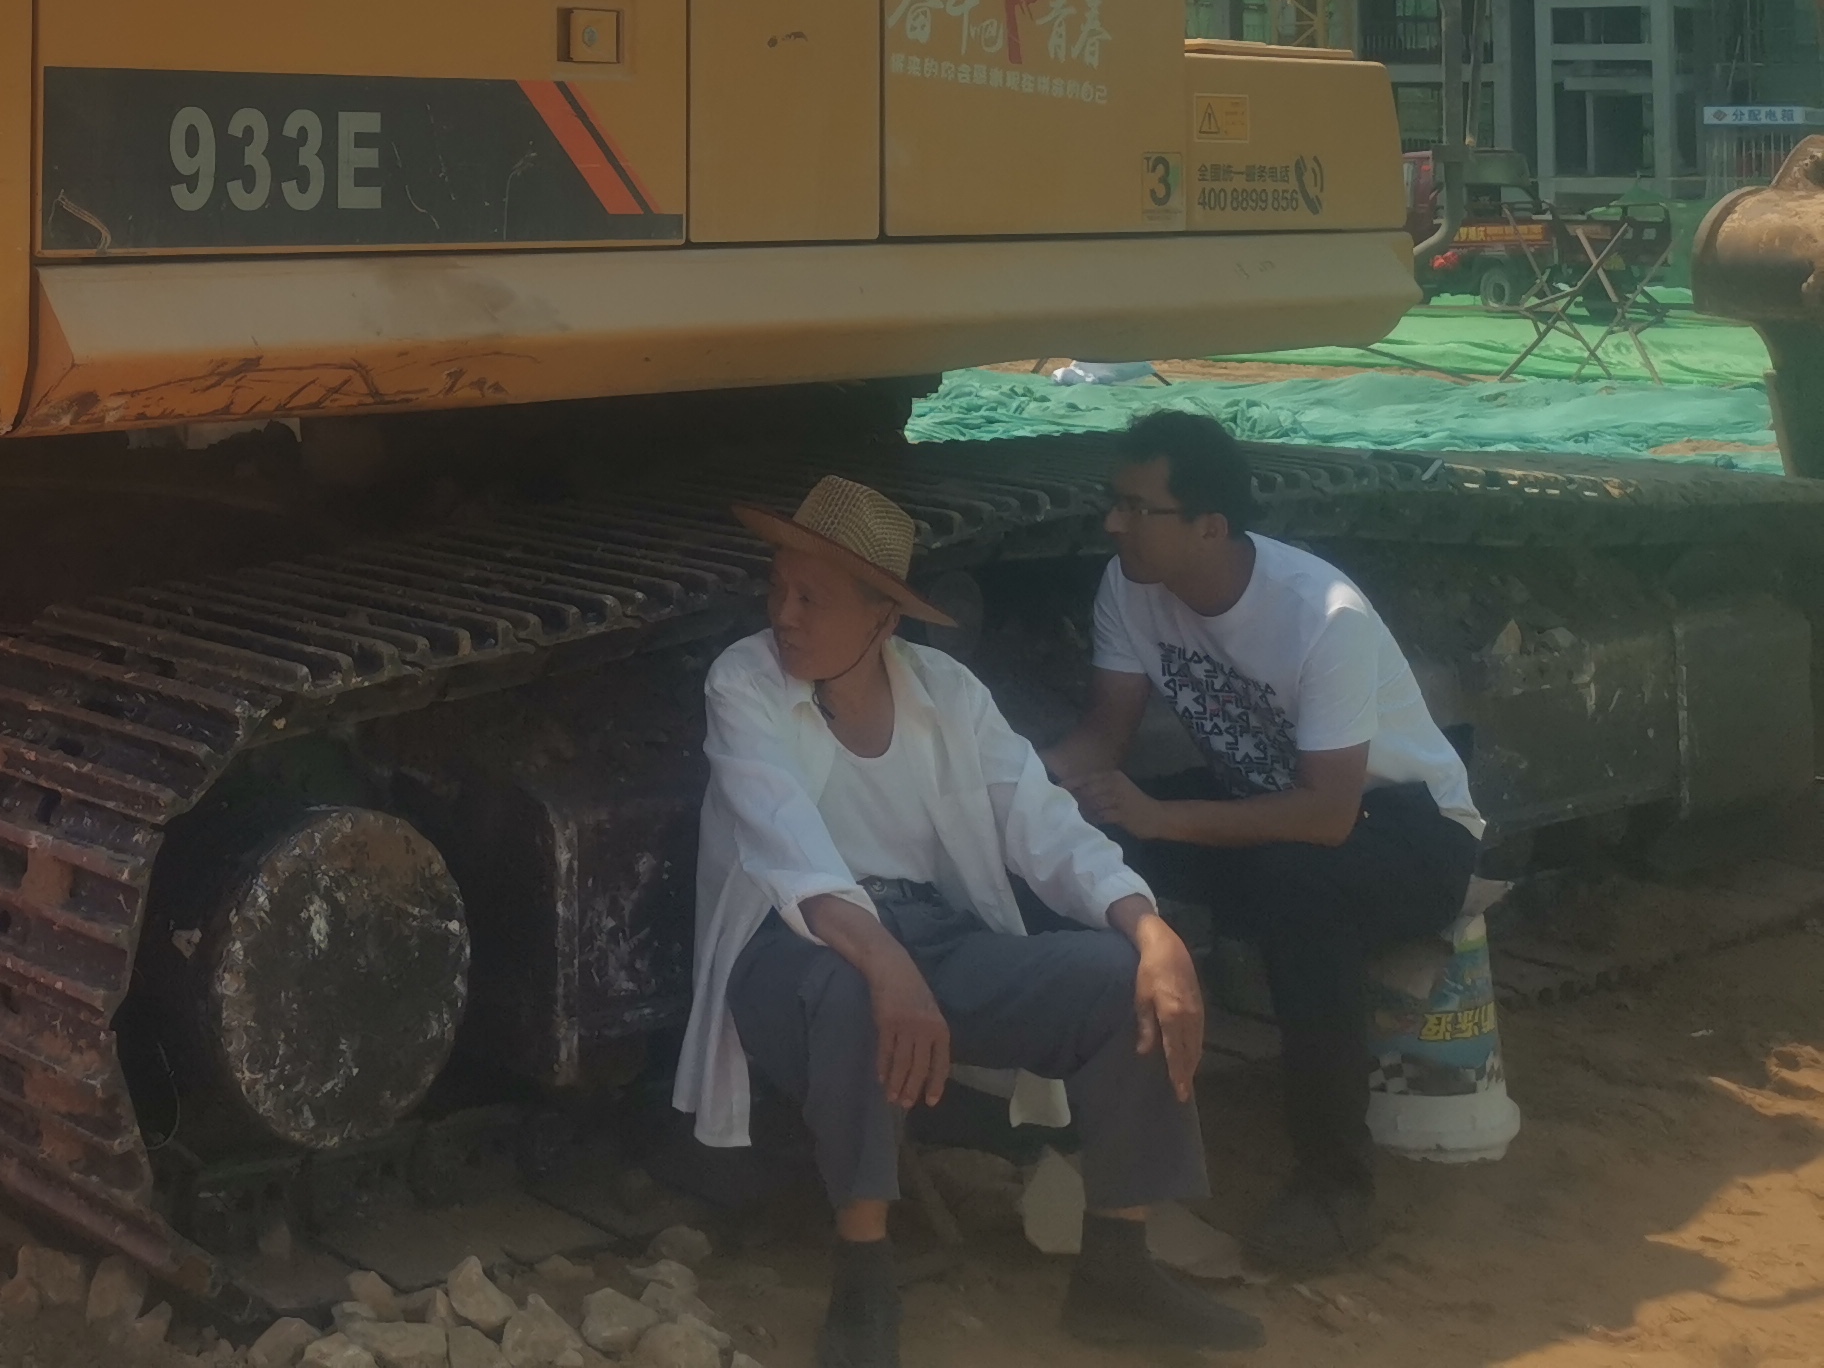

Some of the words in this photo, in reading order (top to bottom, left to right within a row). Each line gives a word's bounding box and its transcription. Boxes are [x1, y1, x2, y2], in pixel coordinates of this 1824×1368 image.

[169, 106, 383, 212] 933E
[1197, 164, 1290, 183] 全国统一服务电话
[1197, 187, 1226, 211] 400
[1230, 188, 1268, 212] 8899
[1271, 188, 1299, 212] 856
